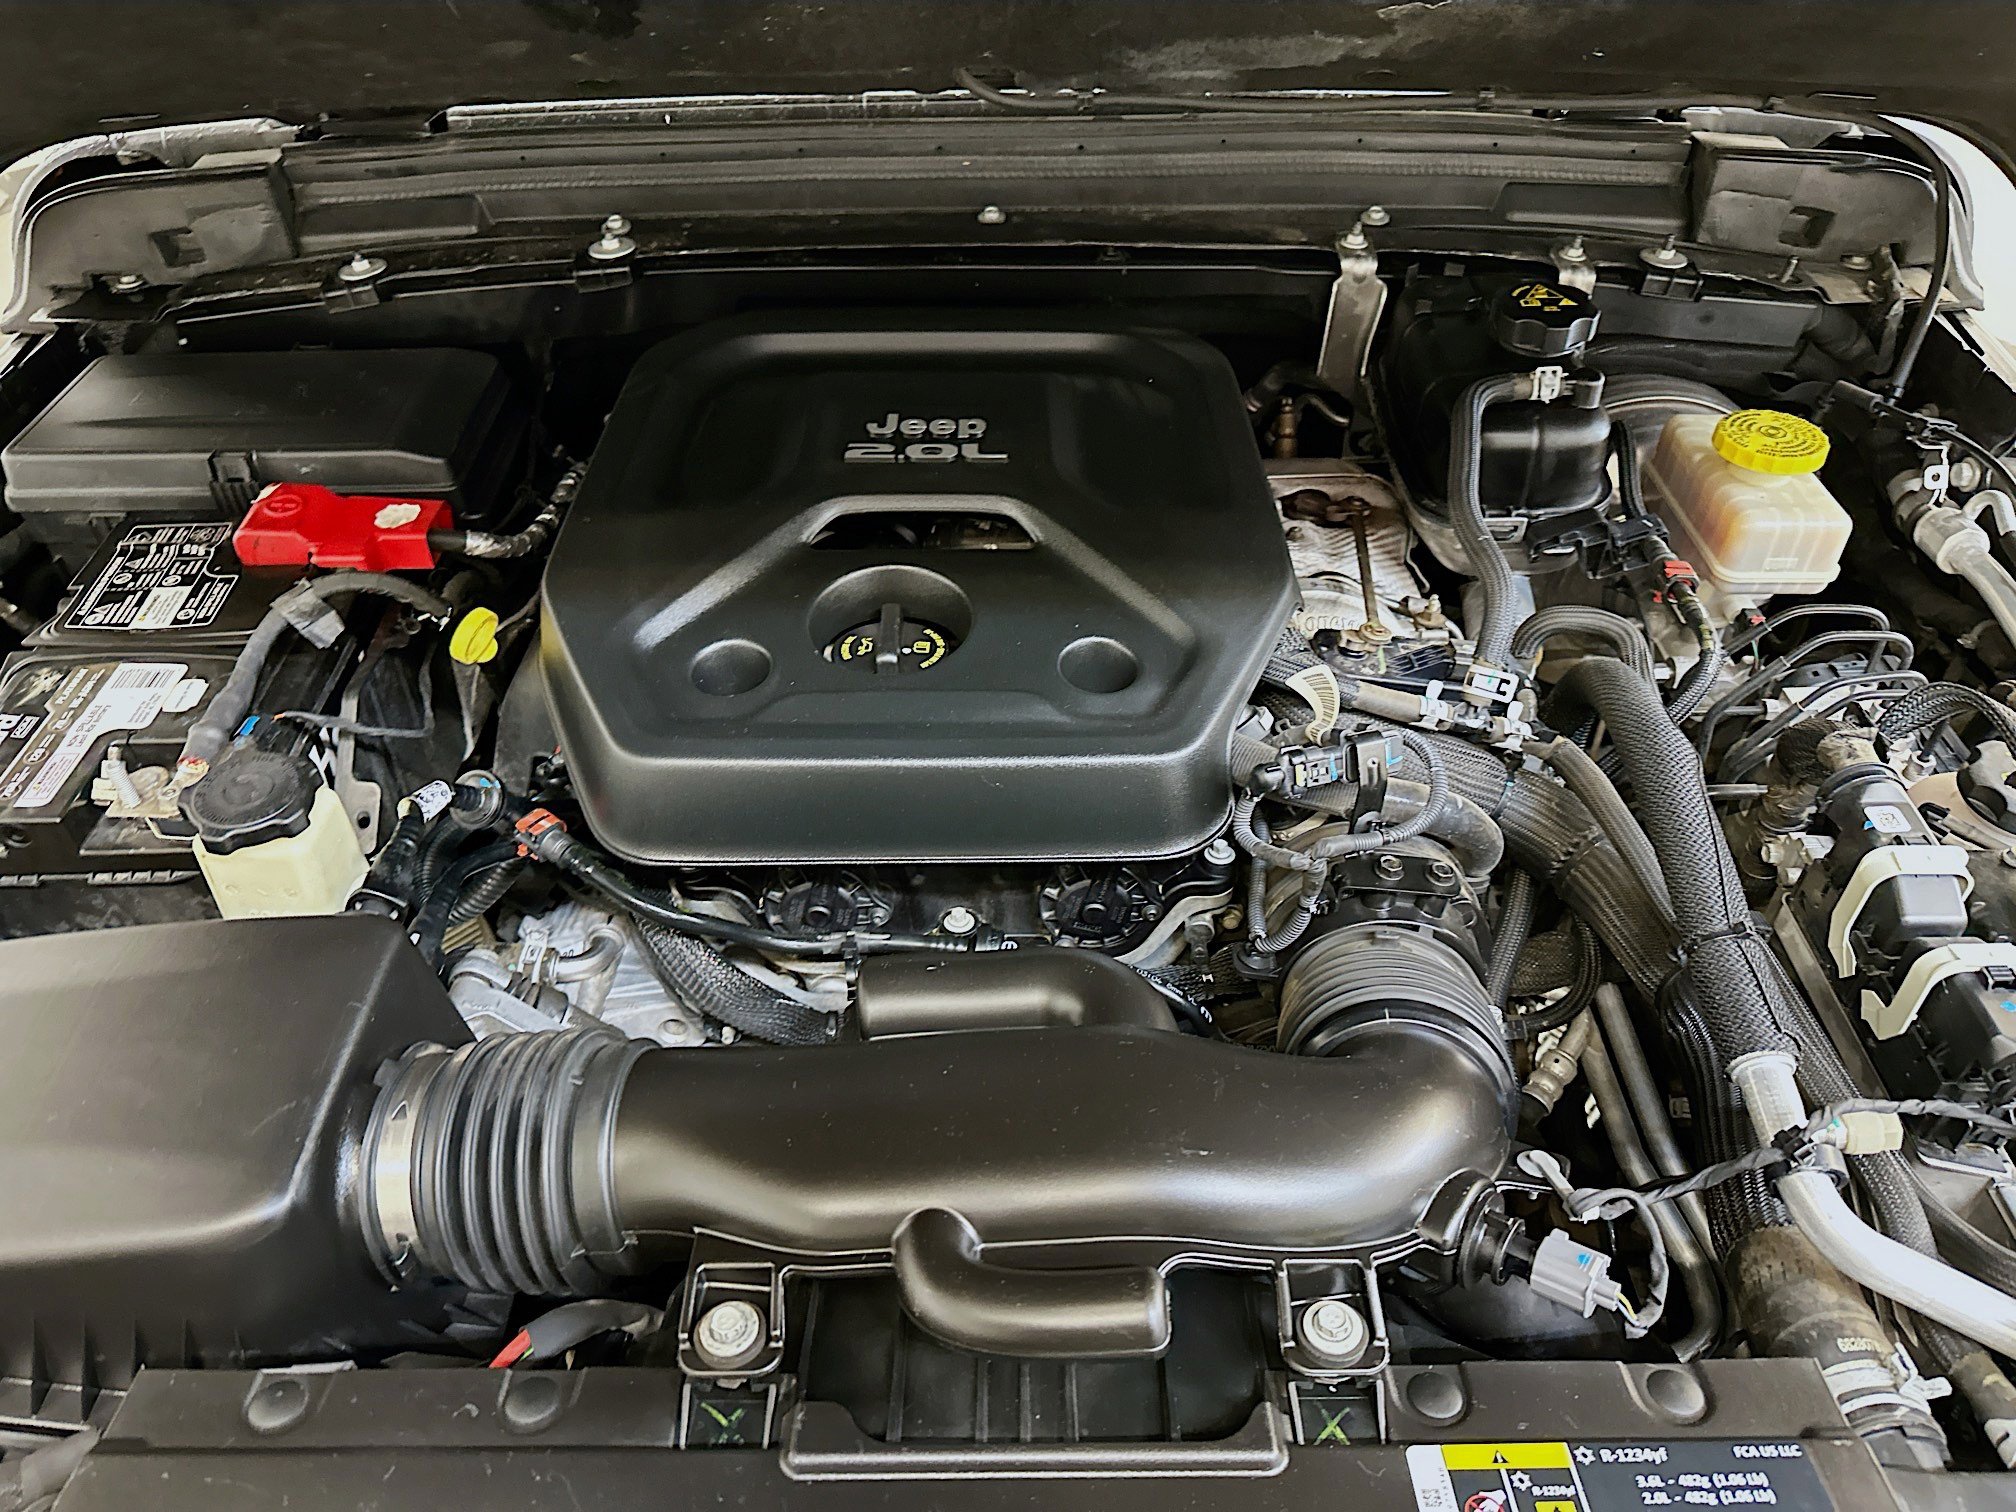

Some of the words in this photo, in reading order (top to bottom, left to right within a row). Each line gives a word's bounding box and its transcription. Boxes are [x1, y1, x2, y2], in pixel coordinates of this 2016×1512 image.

[866, 413, 987, 438] Jeep
[844, 443, 1009, 463] 2.0L
[1599, 1446, 1668, 1465] R-1234yf
[1732, 1445, 1760, 1458] FCA
[1758, 1445, 1778, 1457] US
[1778, 1444, 1802, 1457] LLC
